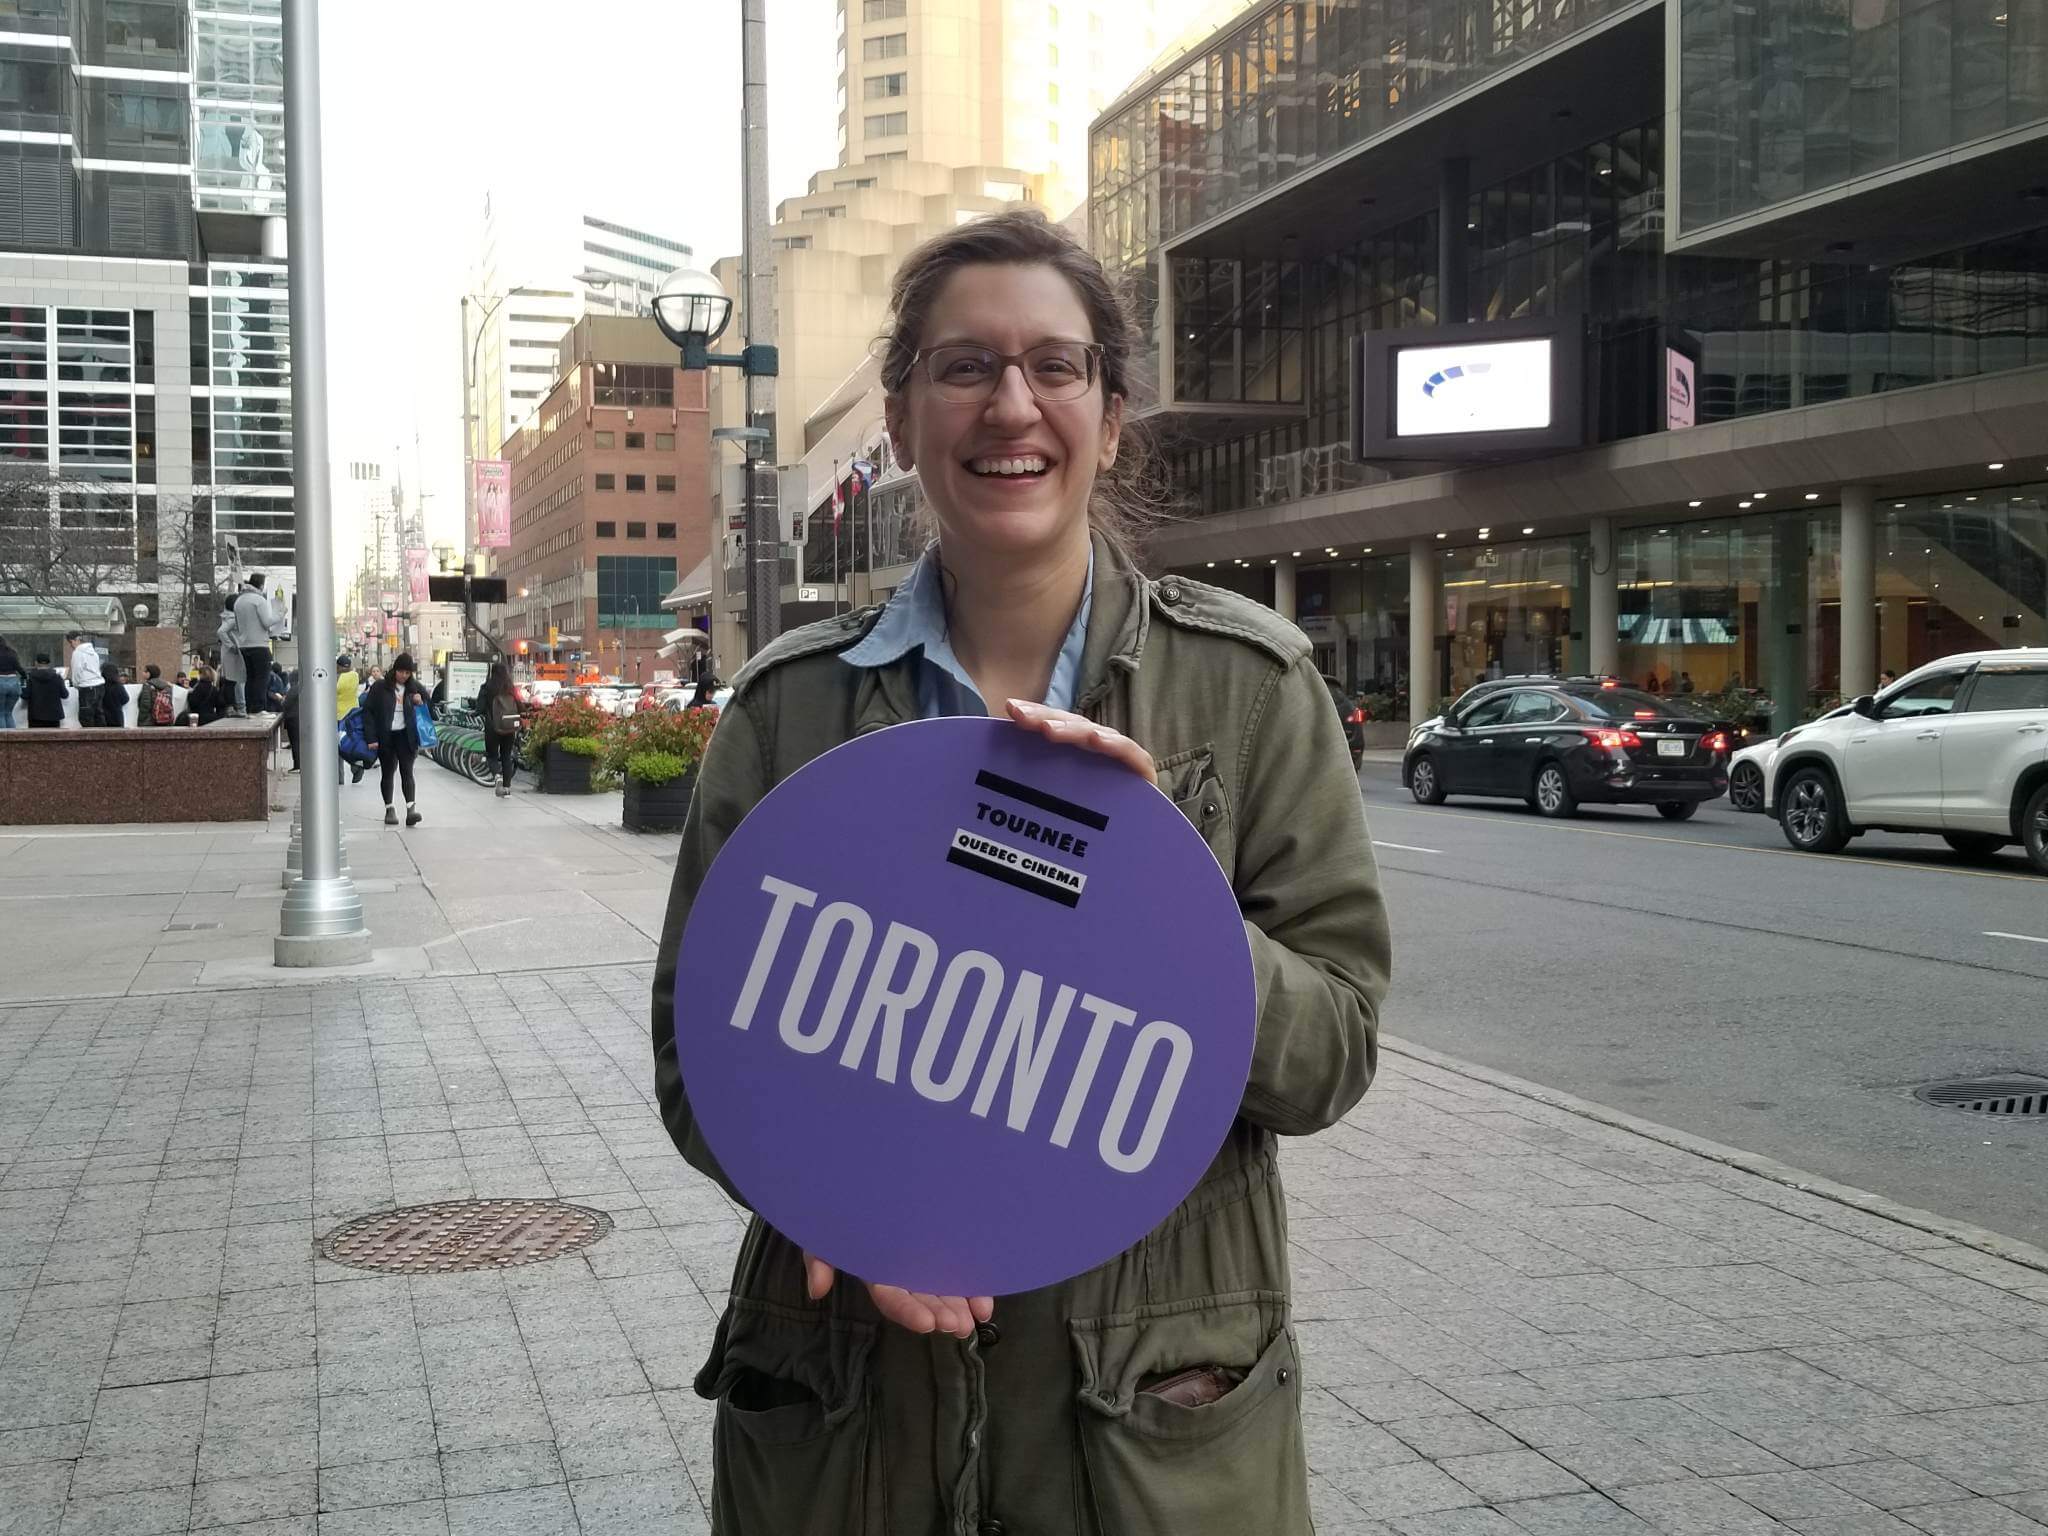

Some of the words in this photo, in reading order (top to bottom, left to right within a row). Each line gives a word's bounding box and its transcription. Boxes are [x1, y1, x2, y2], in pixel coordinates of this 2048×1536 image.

[977, 802, 1088, 858] TOURNÉE
[958, 835, 1018, 864] QUÉBEC
[1021, 858, 1079, 888] CINÉMA
[730, 874, 1193, 1173] TORONTO
